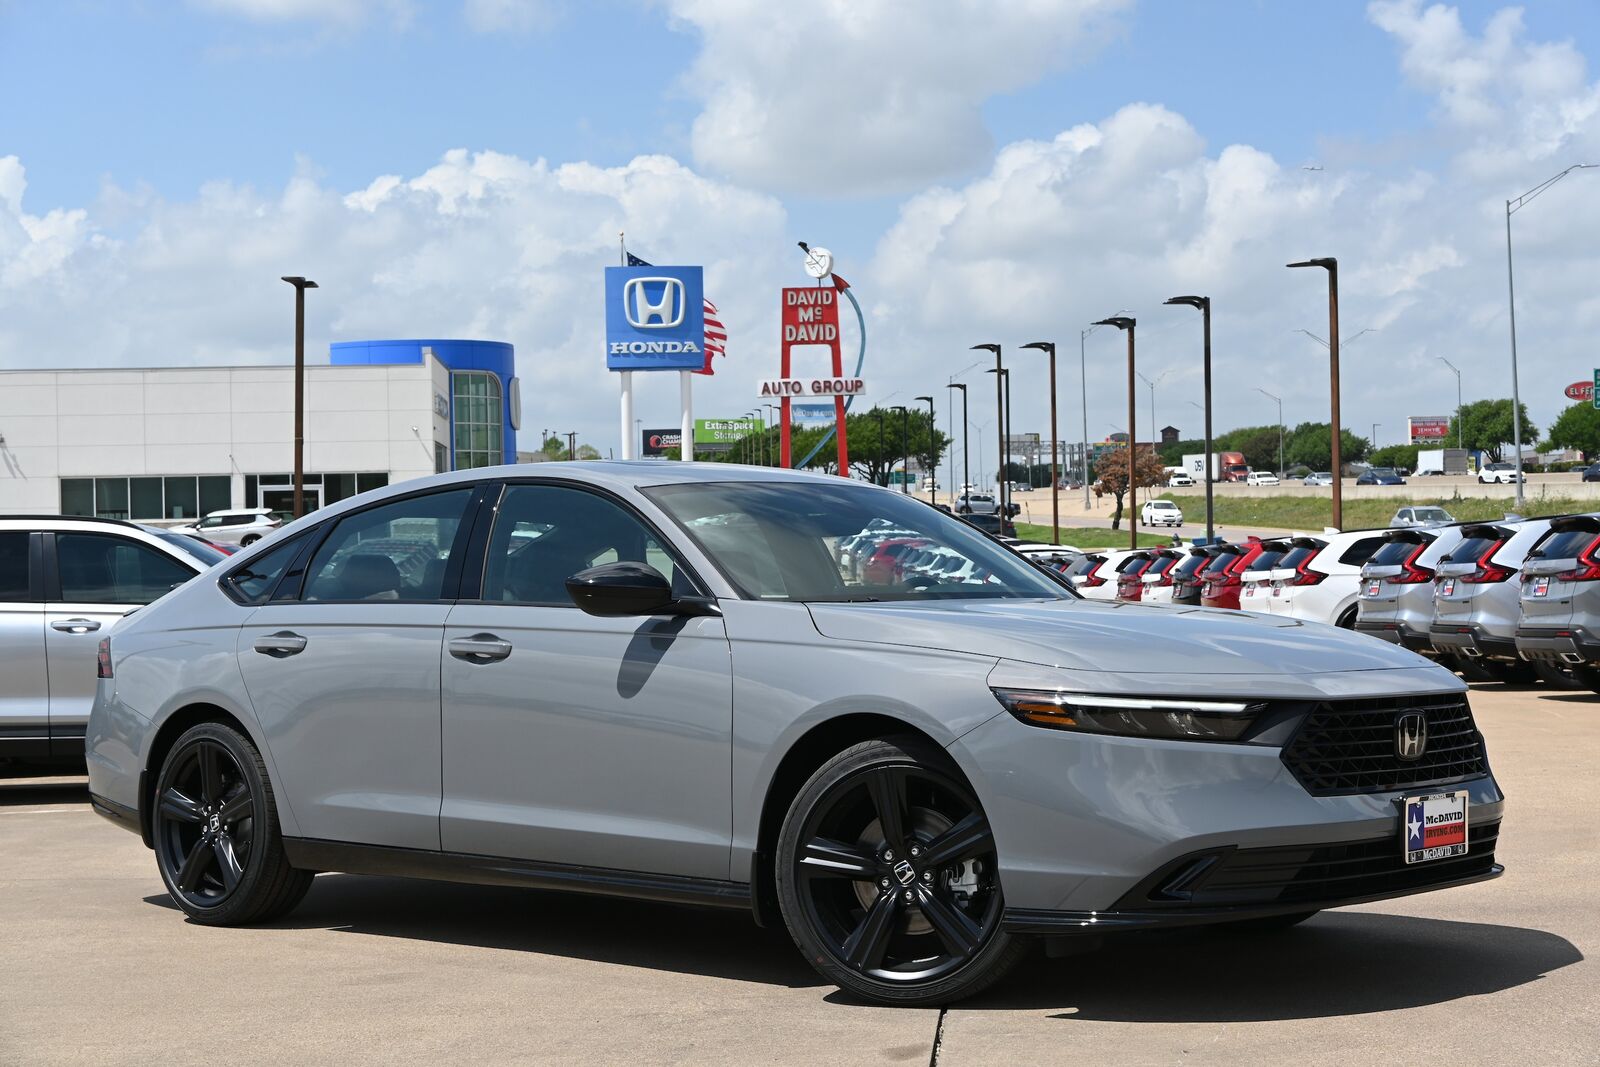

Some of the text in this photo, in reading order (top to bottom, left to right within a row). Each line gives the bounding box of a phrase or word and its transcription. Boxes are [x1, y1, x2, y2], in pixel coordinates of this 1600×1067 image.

[787, 290, 832, 306] DAVID
[785, 323, 836, 341] DAVID
[609, 341, 701, 354] HONDA
[761, 380, 863, 395] AUTO GROUP
[1570, 387, 1579, 395] EL
[714, 431, 746, 441] Storag
[1425, 811, 1463, 825] McDAVID
[1425, 825, 1464, 838] IRVING.COM
